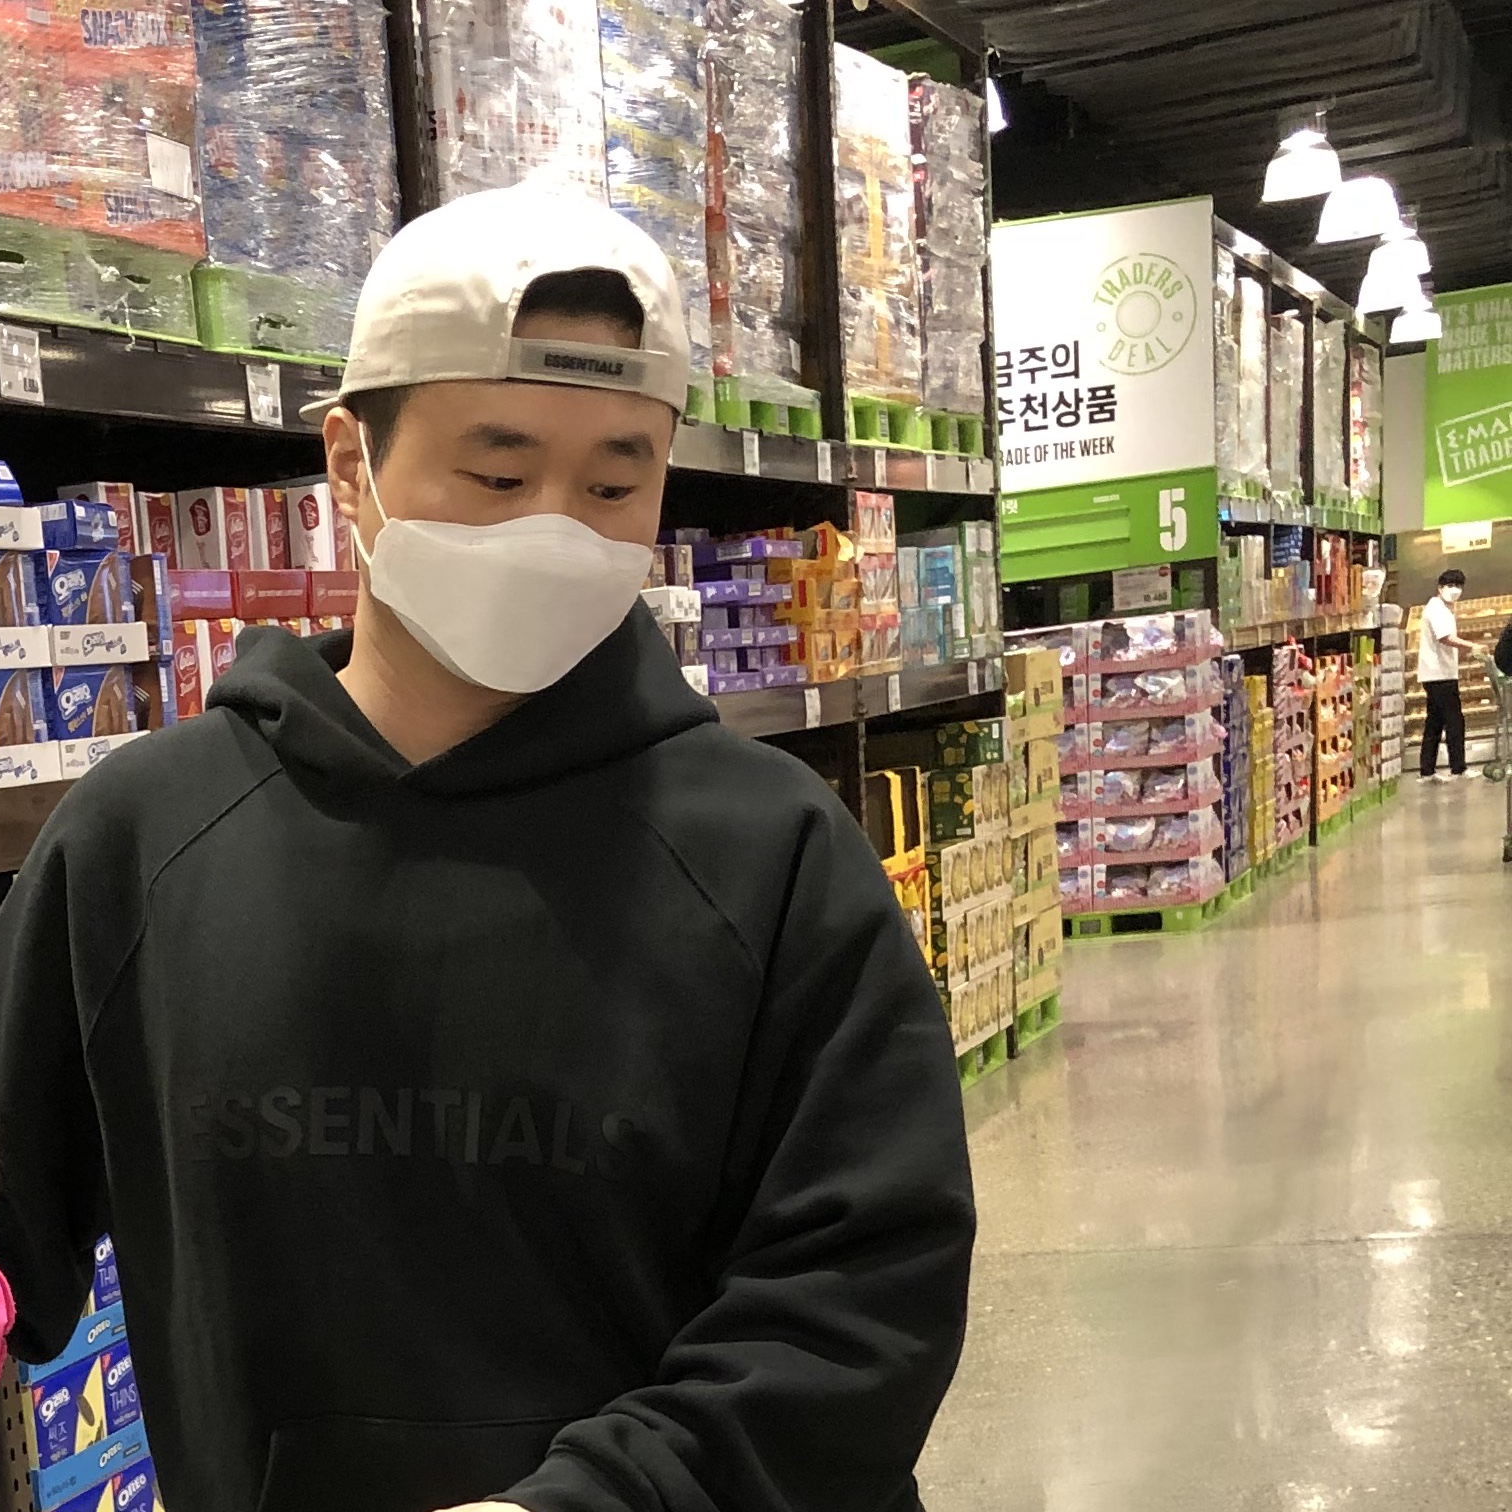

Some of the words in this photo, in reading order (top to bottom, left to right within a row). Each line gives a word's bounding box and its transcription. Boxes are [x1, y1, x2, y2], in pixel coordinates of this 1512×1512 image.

[1093, 261, 1183, 306] TRADERS
[543, 351, 624, 376] ESSENTIALS
[994, 339, 1081, 388] 금주의
[1108, 336, 1173, 369] DEAL
[1034, 444, 1051, 464] OF
[1052, 439, 1076, 462] THE
[1078, 435, 1116, 457] WEEK
[1158, 487, 1188, 552] 5
[53, 568, 88, 604] 오레오
[58, 683, 93, 720] 오레오
[87, 1318, 111, 1345] OREO
[41, 1386, 71, 1424] 오레오
[99, 1441, 123, 1467] OREO
[118, 1474, 147, 1507] OREO
